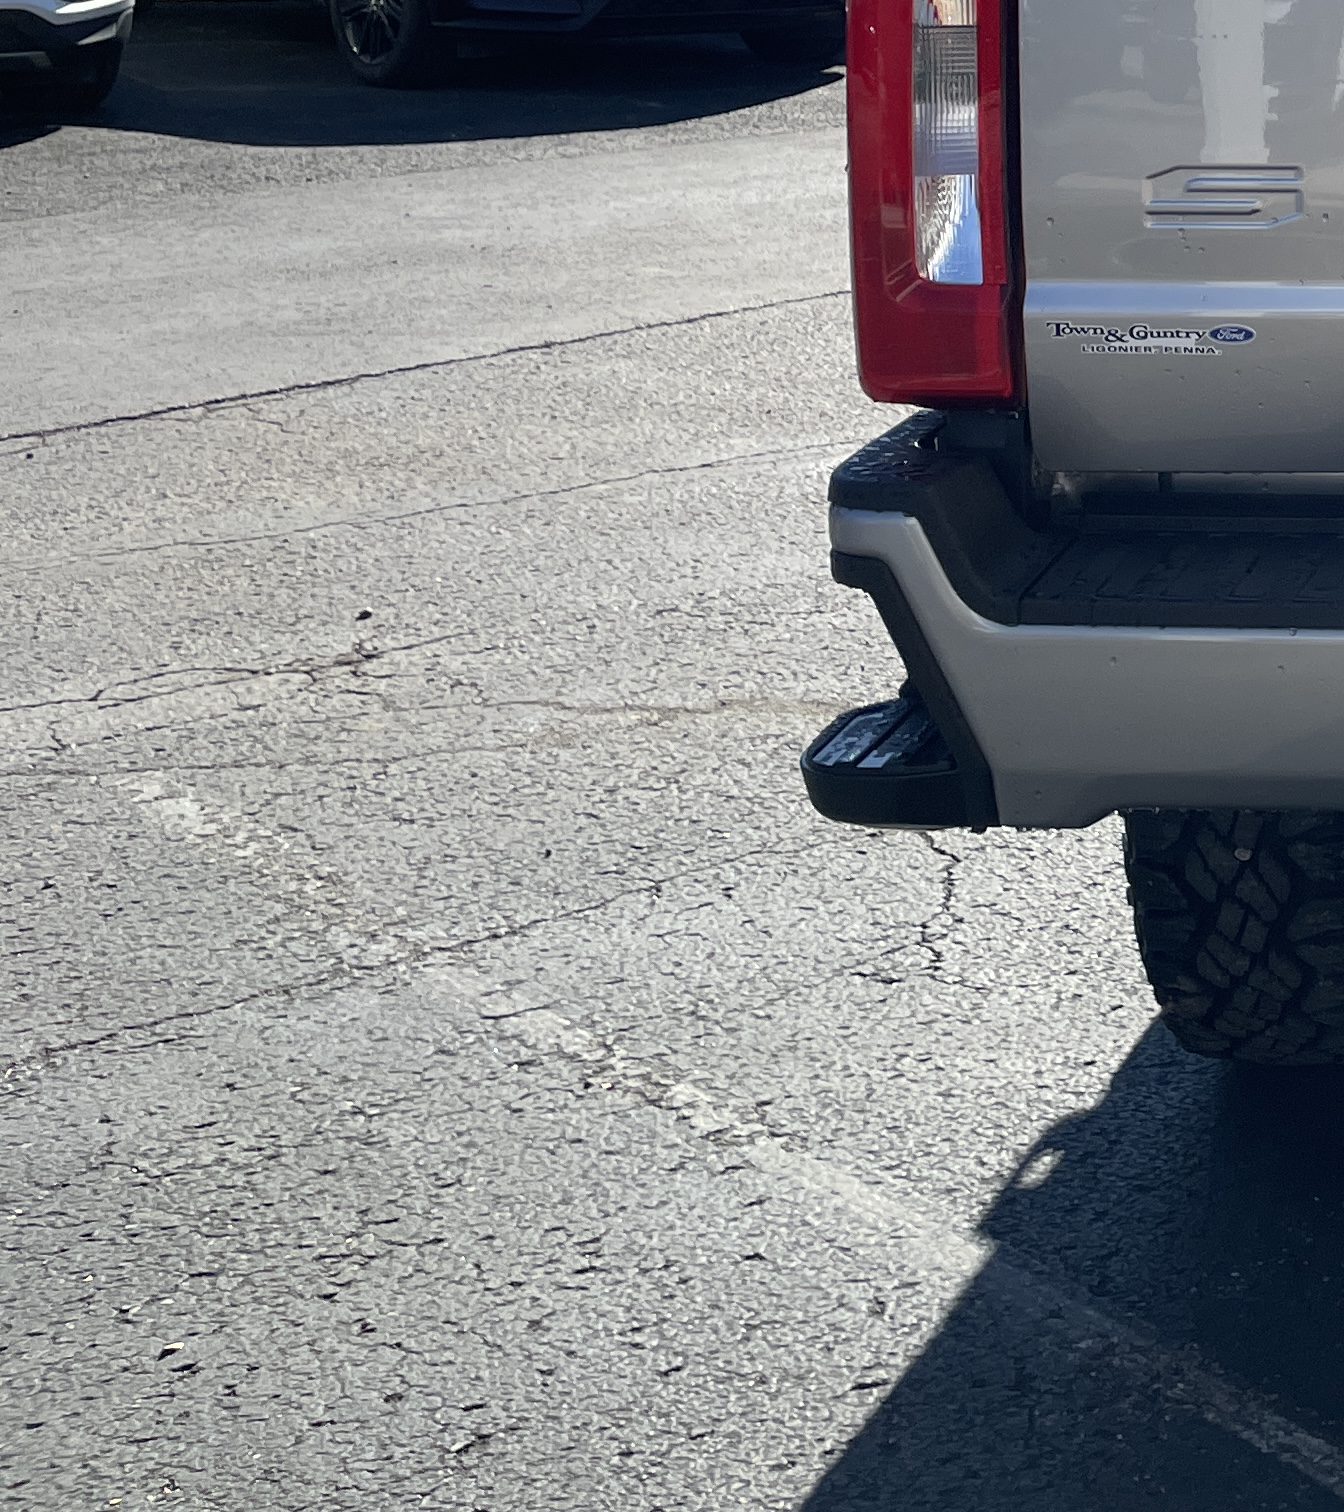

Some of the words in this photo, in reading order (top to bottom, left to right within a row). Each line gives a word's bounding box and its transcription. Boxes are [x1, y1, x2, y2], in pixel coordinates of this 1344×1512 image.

[1046, 322, 1105, 338] Town
[1128, 324, 1207, 342] Country
[1215, 328, 1247, 341] Ford
